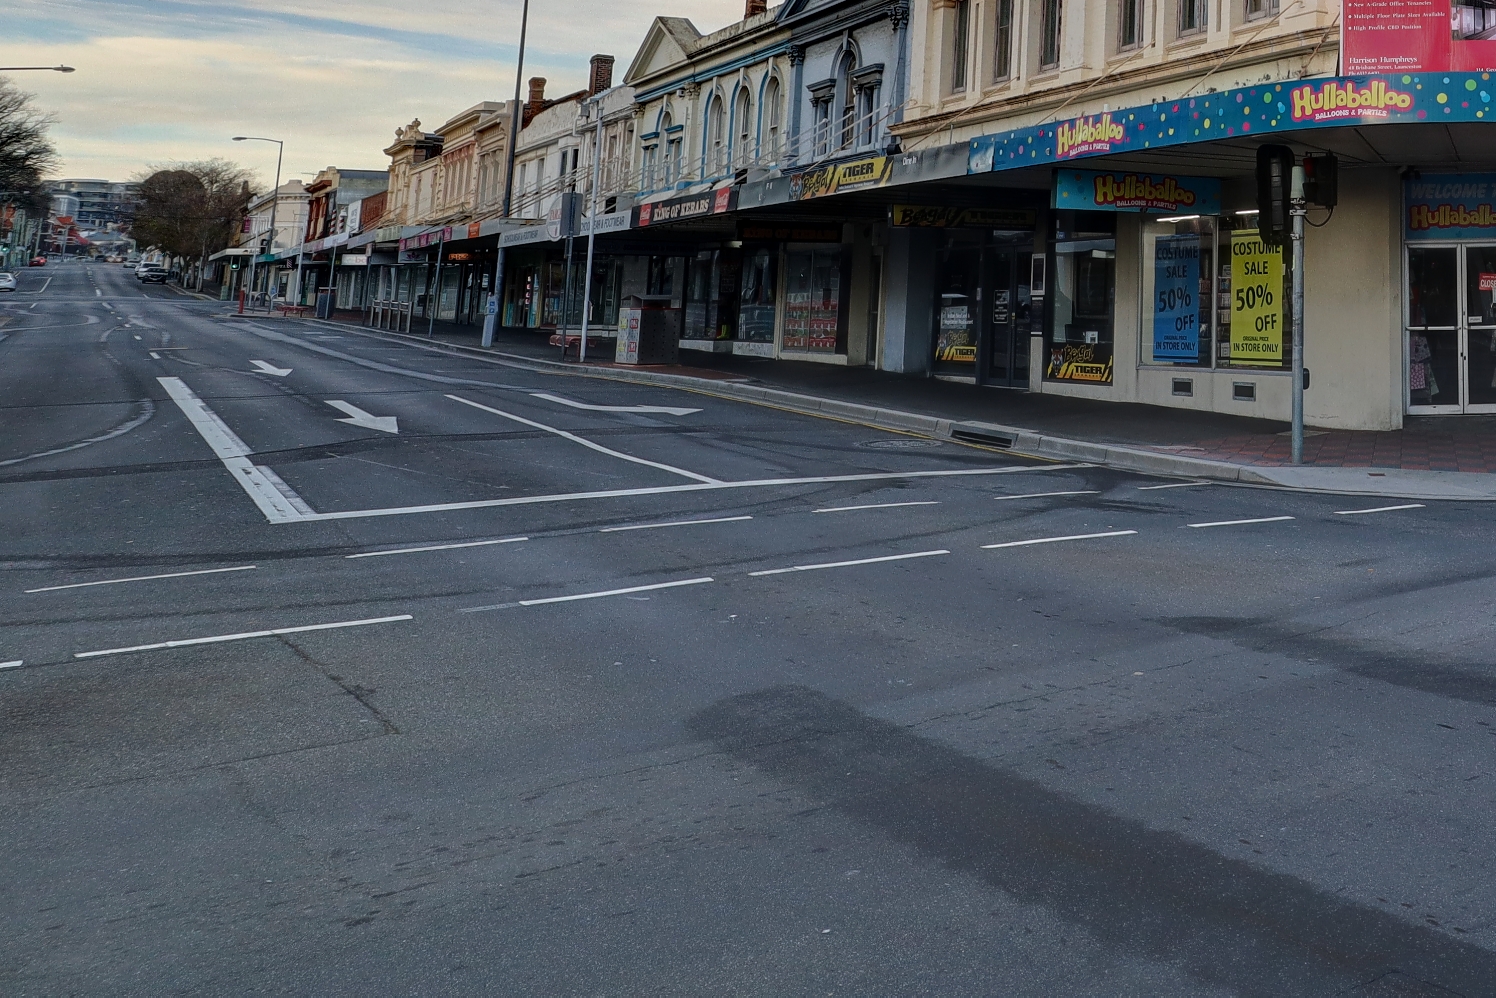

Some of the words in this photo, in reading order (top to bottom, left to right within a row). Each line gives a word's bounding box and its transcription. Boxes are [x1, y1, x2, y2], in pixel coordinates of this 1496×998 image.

[1380, 55, 1418, 64] Humphreys
[1292, 80, 1411, 118] Hullaballoo
[1315, 109, 1350, 120] BALLOONS
[1357, 108, 1388, 117] PARTIES
[1056, 114, 1124, 155] Hullaballoo
[1069, 143, 1089, 157] BALLOONS
[1093, 141, 1110, 151] PARTIES
[841, 162, 874, 179] TIGER
[1095, 175, 1194, 203] Hullaballoo
[1411, 183, 1488, 199] WELCOME
[653, 205, 671, 222] KING
[670, 204, 680, 218] OF
[680, 199, 710, 217] KEBABS
[1153, 201, 1177, 211] PARTIES
[967, 210, 1027, 220] TIGER
[1157, 247, 1198, 260] COSTUME
[1233, 241, 1281, 256] COSTUME
[1166, 265, 1188, 279] SALE
[1244, 261, 1269, 276] SALE
[1158, 285, 1191, 313] 50%
[1236, 283, 1273, 312] 50%
[1175, 314, 1195, 332] OFF
[1255, 313, 1277, 332] OFF
[1155, 342, 1161, 350] IN
[1161, 342, 1181, 350] STORE
[1181, 342, 1196, 351] ONLY
[1233, 343, 1240, 351] IN
[1241, 343, 1261, 352] STORE
[1262, 343, 1279, 353] ONLY
[1074, 365, 1103, 374] TIGER
